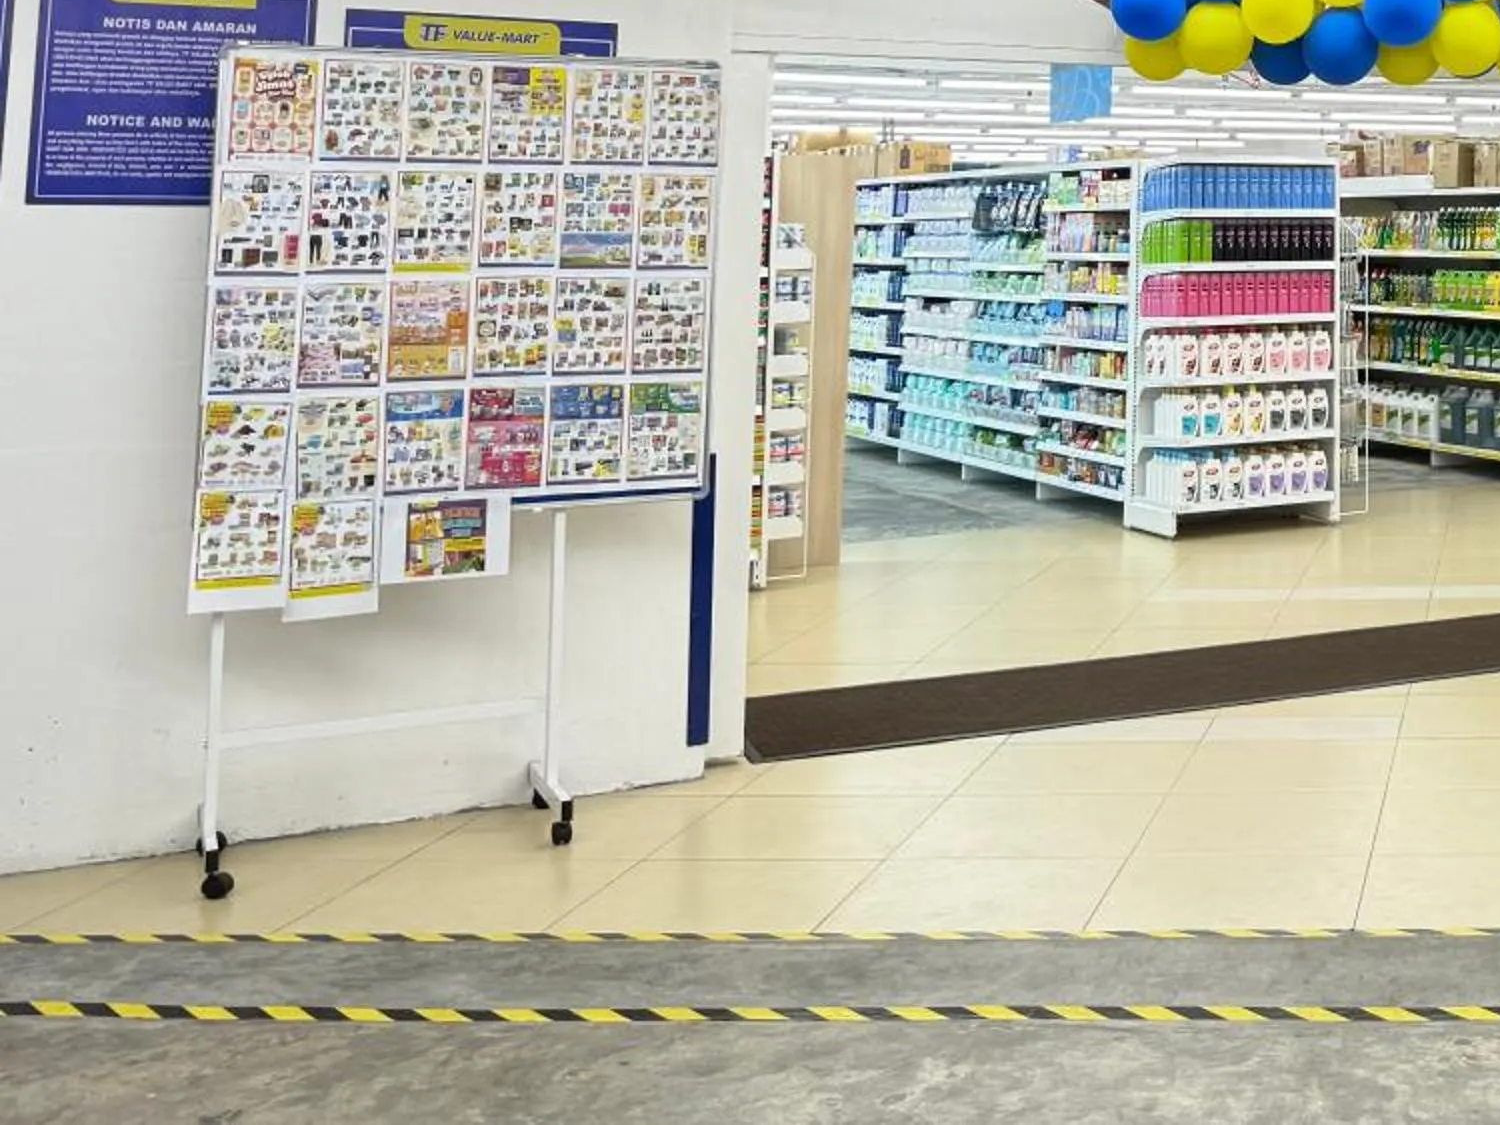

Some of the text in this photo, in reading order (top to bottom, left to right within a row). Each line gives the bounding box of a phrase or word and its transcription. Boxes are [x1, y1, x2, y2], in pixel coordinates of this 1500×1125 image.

[103, 17, 257, 34] NOTIS DAN AMARAN
[452, 30, 540, 44] VALUE-MART
[86, 114, 145, 127] NOTICE
[150, 116, 183, 128] AND
